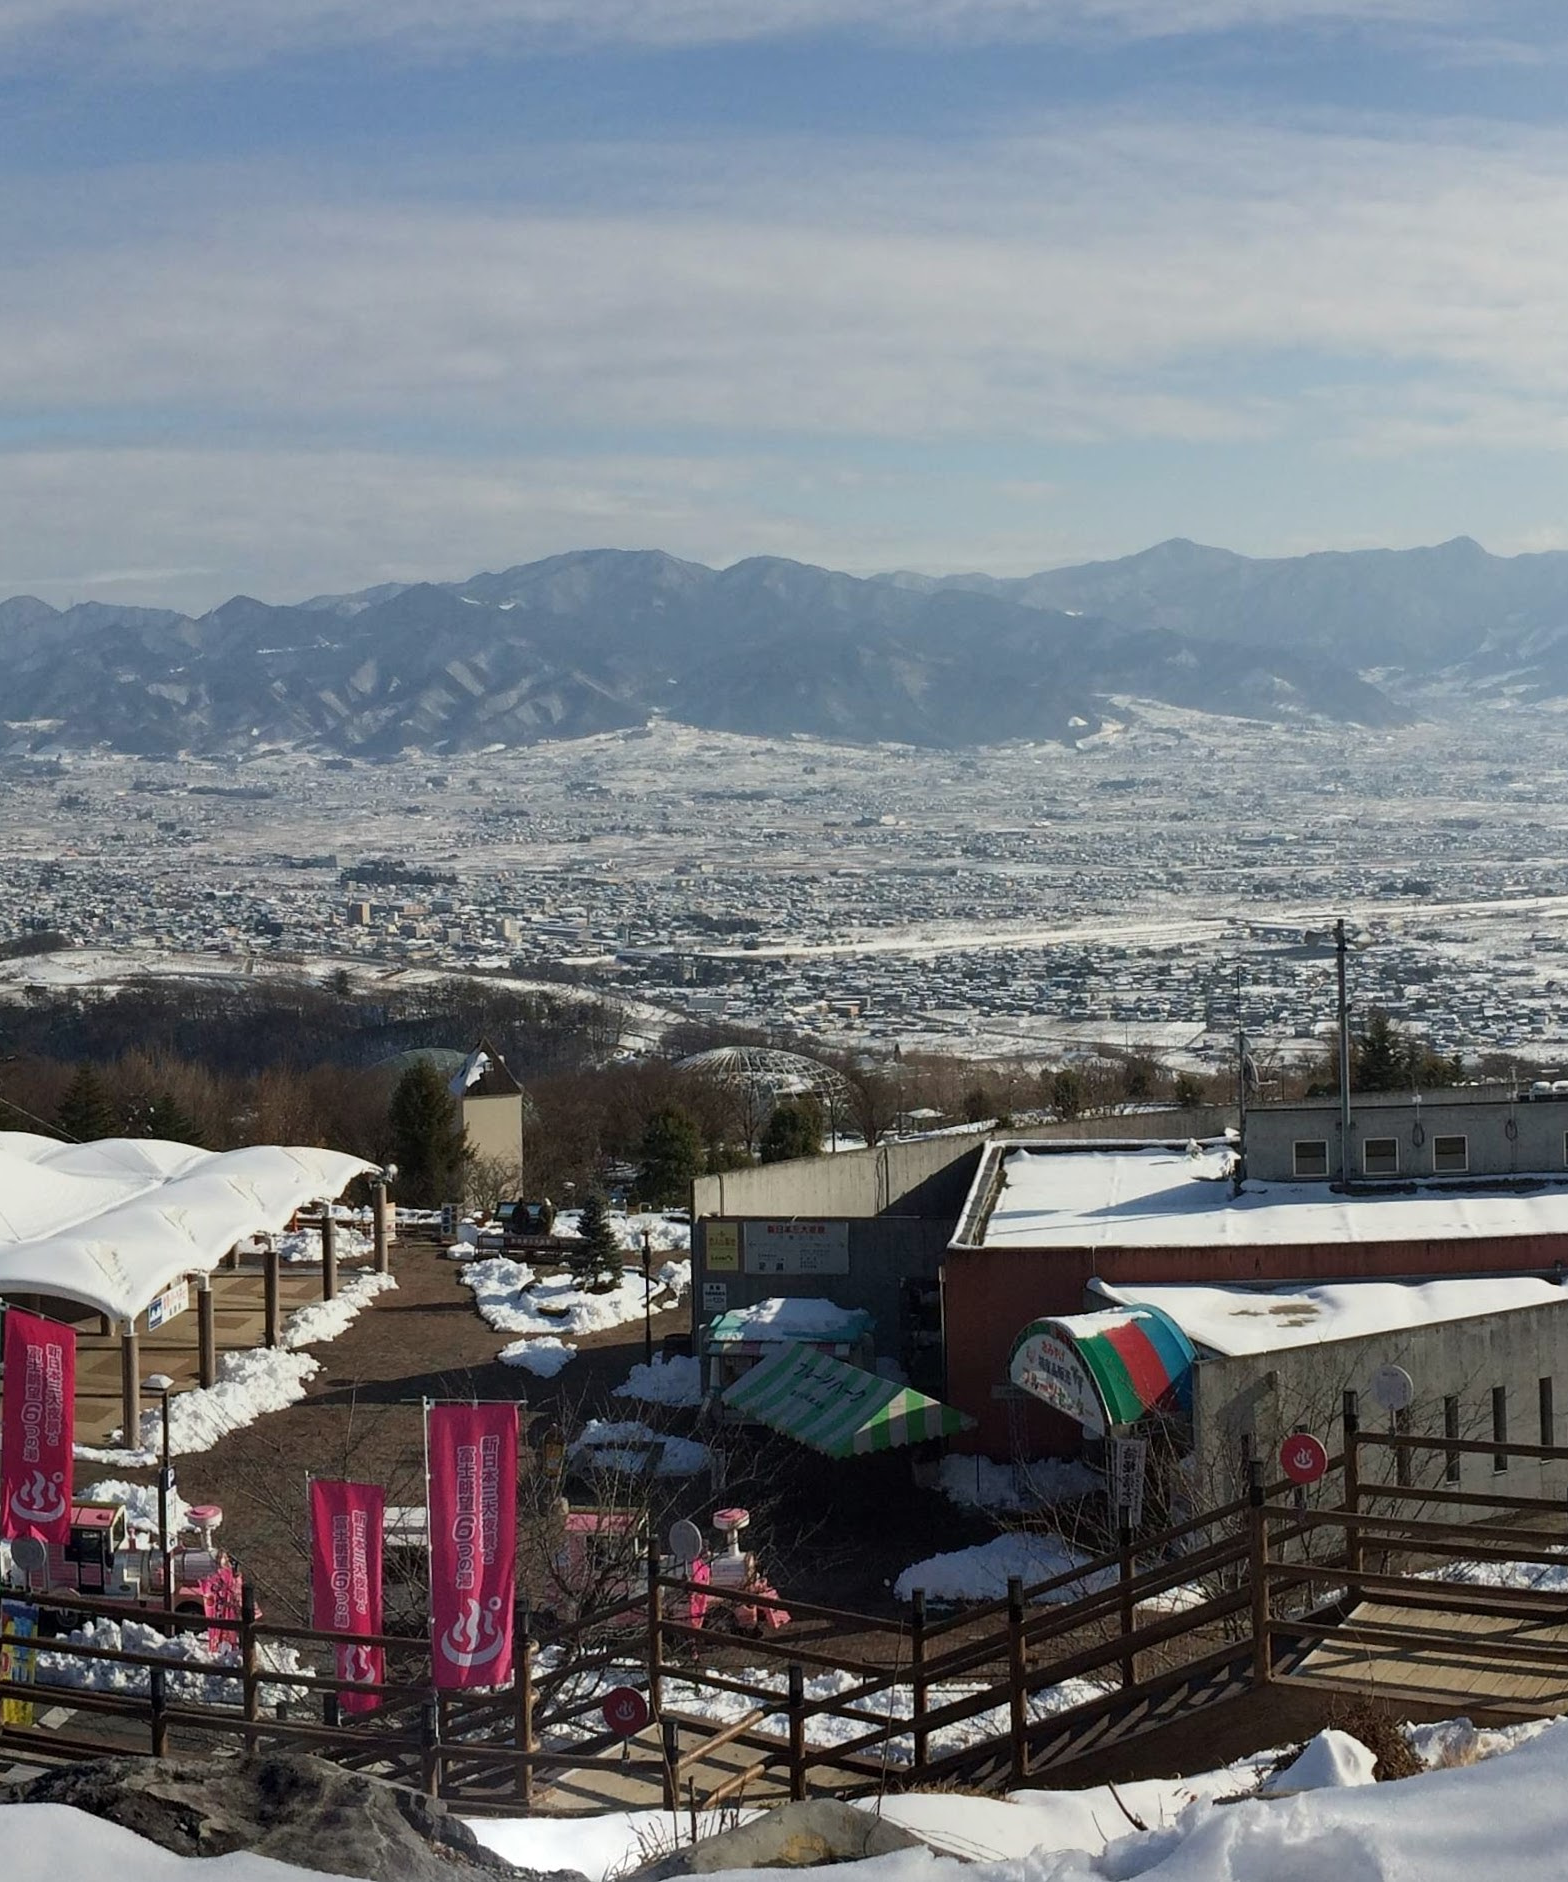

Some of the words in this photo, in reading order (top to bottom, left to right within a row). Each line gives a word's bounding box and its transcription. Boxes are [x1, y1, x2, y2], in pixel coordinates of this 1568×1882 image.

[452, 1445, 477, 1590] 富士眺望6つの湯
